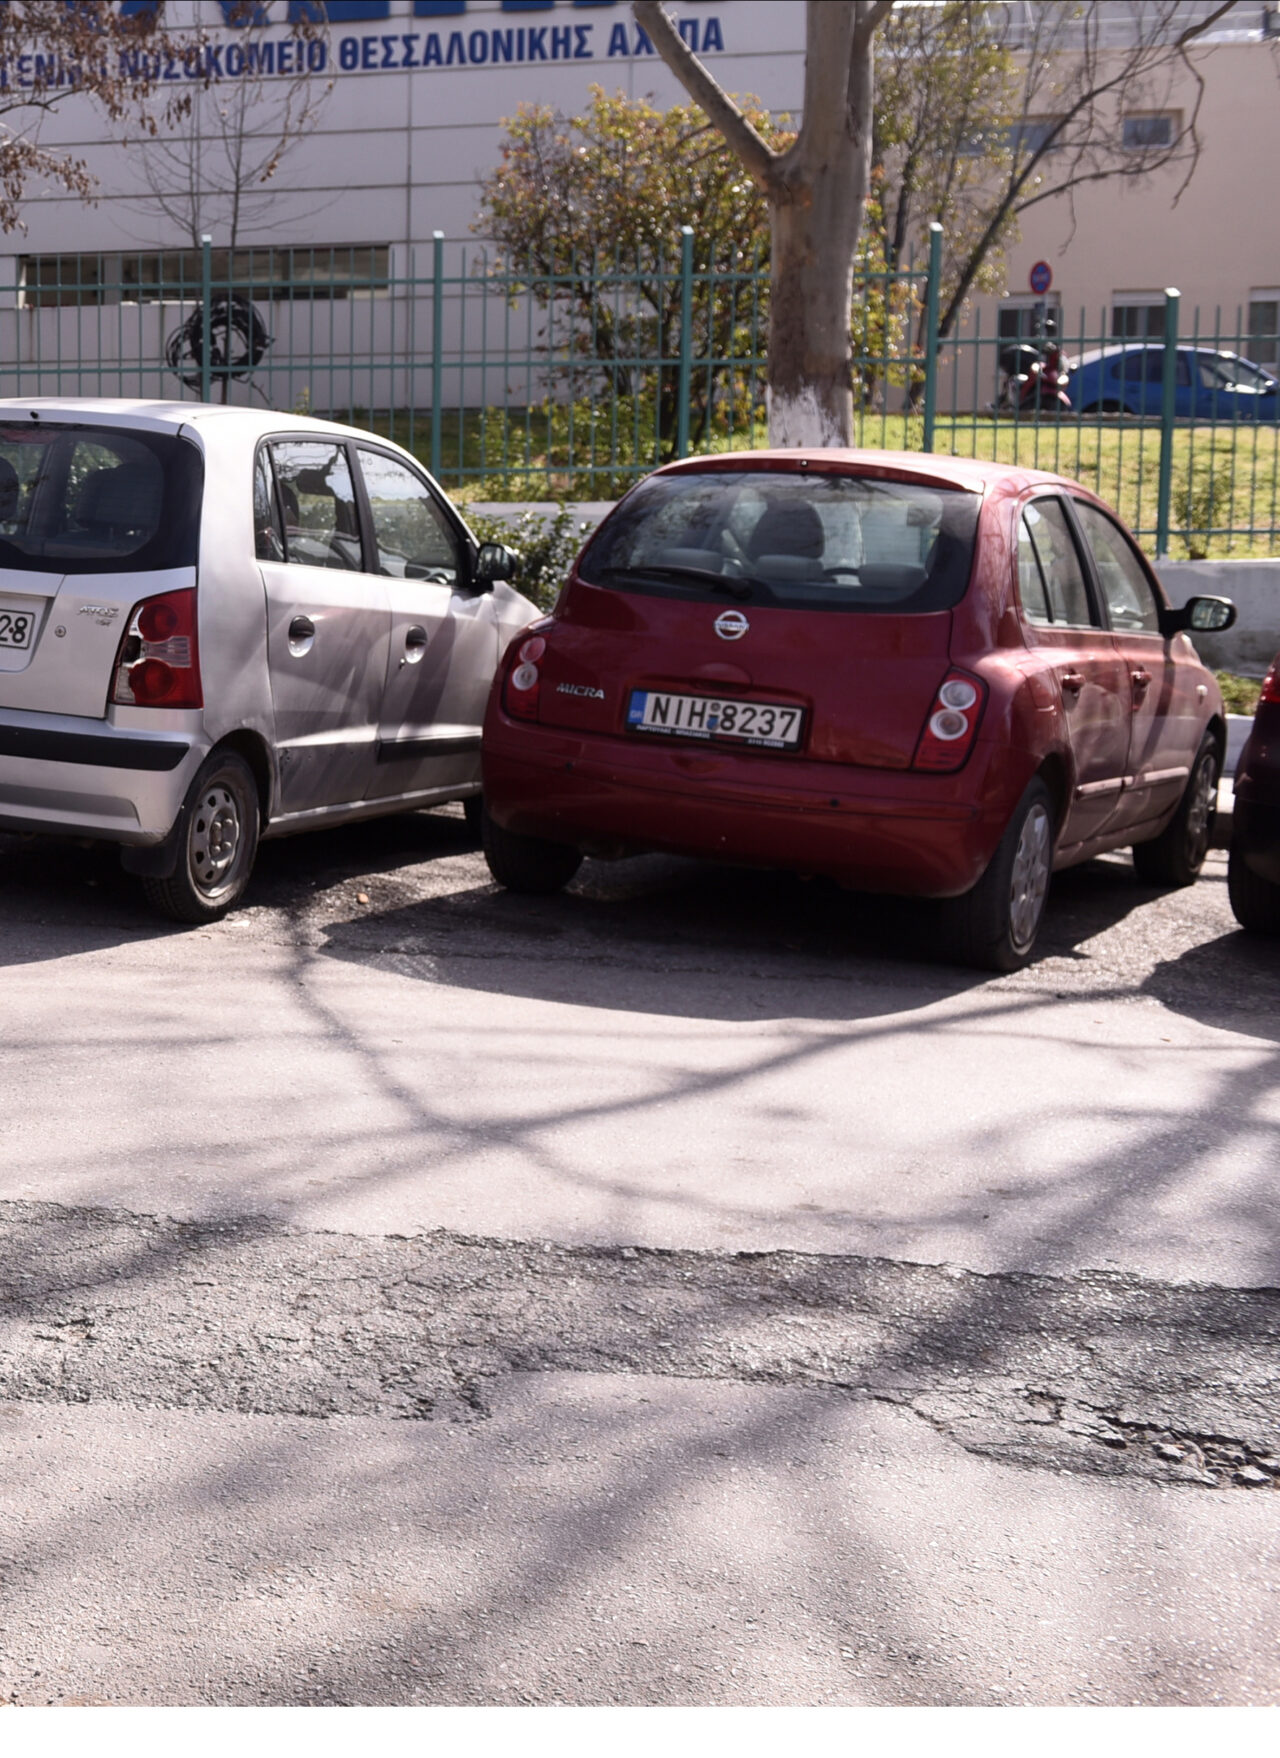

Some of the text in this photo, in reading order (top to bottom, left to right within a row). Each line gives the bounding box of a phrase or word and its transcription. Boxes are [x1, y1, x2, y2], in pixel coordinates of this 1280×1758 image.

[339, 24, 593, 71] ΘΕΣΣΑΛΟΝΙΚΗΣ
[607, 17, 724, 58] ΑΧΠΑ
[556, 682, 605, 700] MICRA
